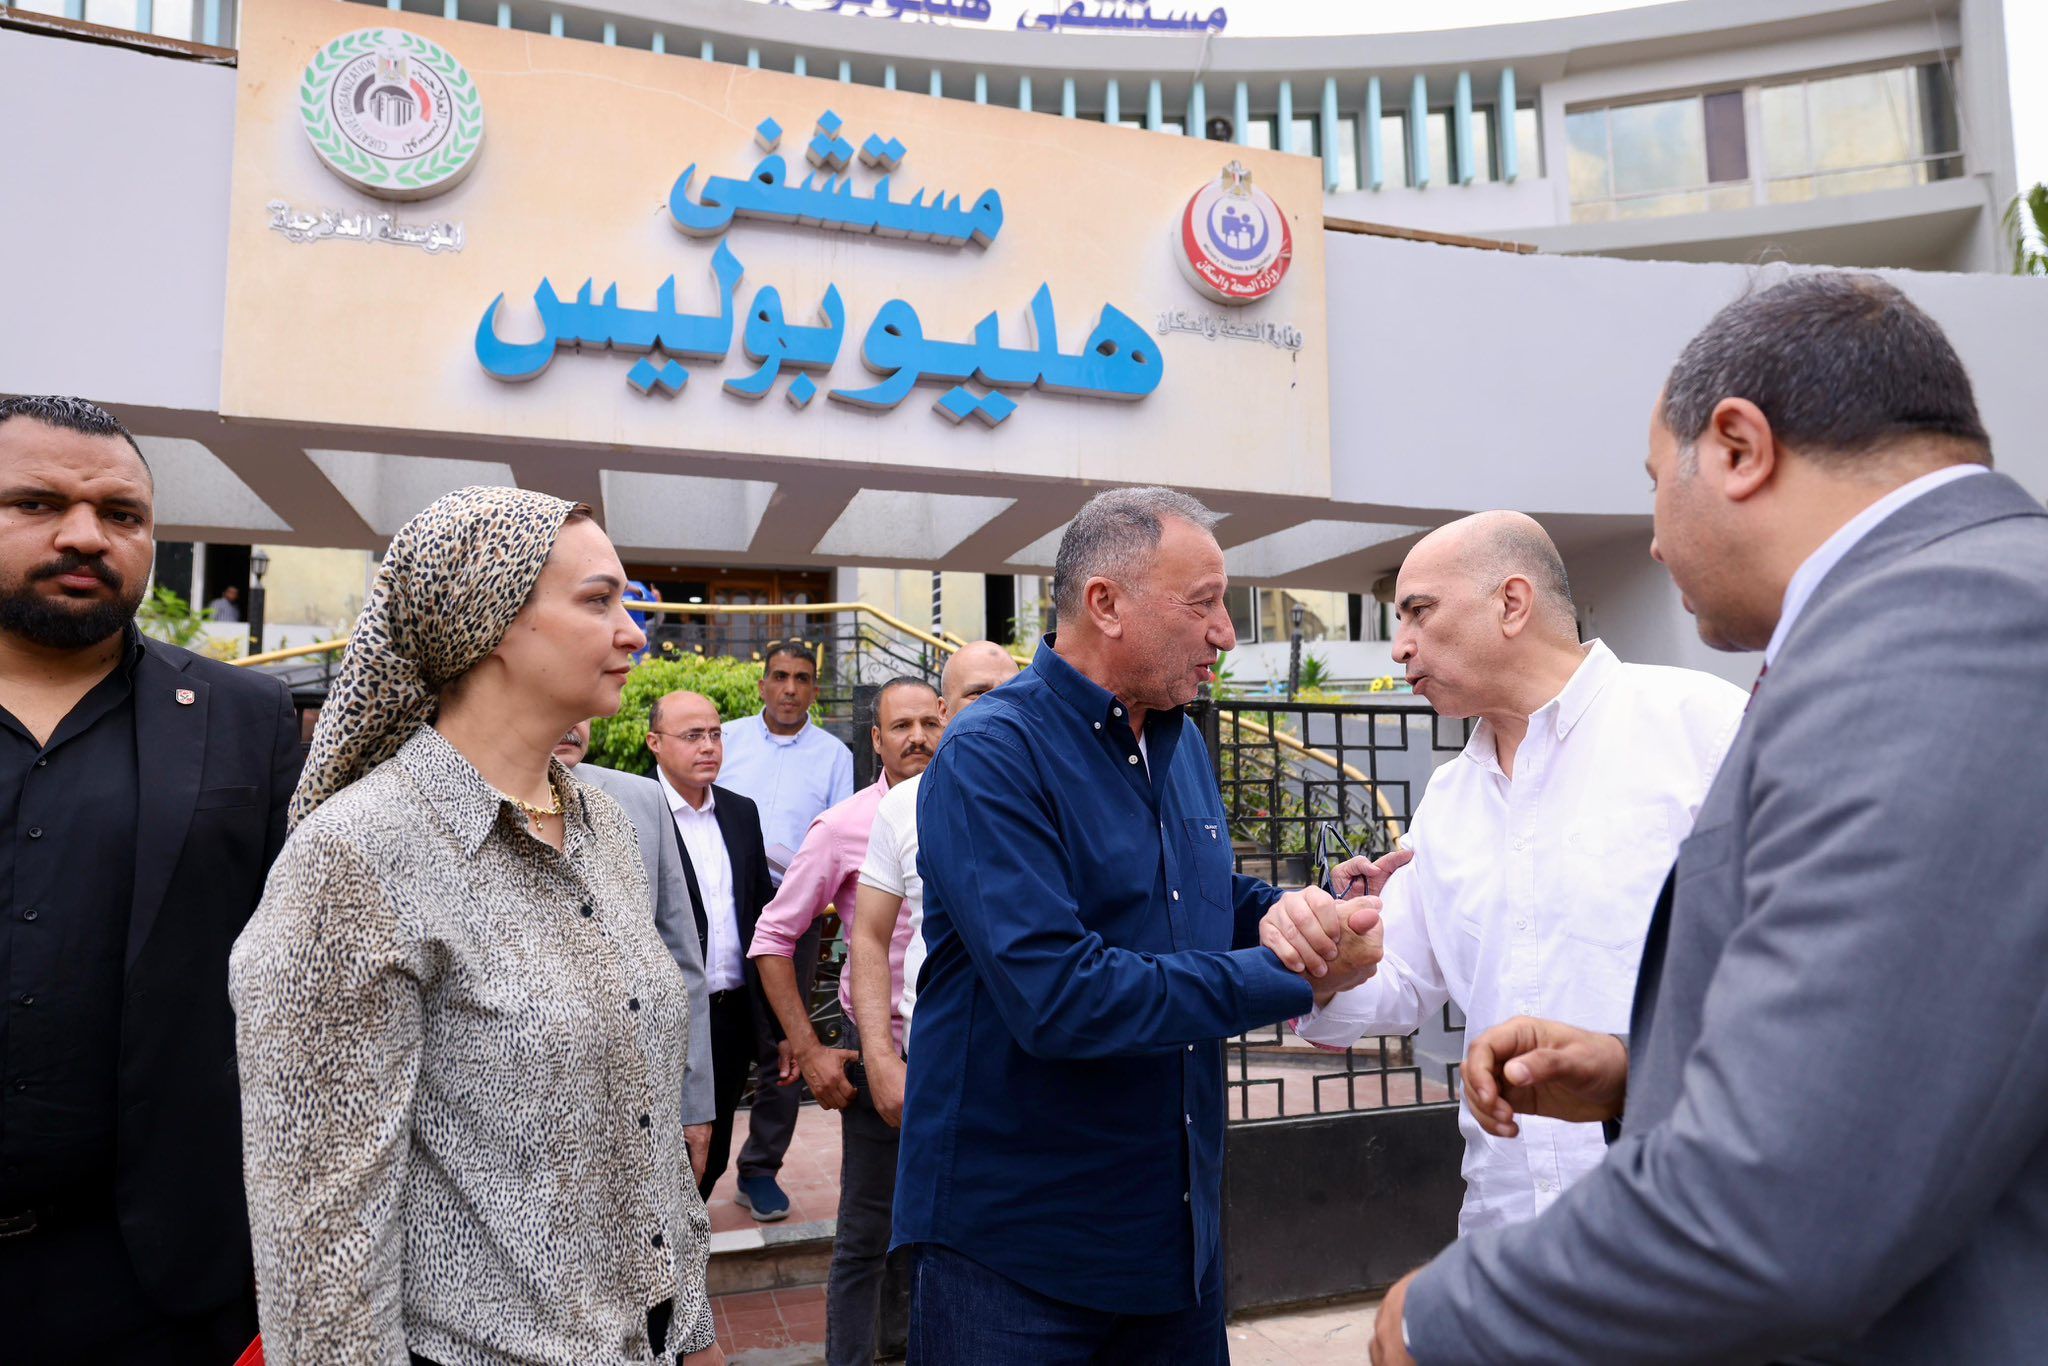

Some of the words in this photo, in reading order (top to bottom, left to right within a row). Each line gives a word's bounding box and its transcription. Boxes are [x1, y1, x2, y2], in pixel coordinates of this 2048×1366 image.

[339, 58, 376, 118] ORGANIZATION
[343, 117, 388, 152] CURATIVE
[668, 110, 1004, 249] مستشفى
[267, 201, 374, 243] العلاجية
[1196, 260, 1230, 291] والسكان
[1230, 277, 1259, 293] الصحة
[475, 237, 1164, 428] هليوبوليس
[1157, 311, 1217, 340] والسكان
[1218, 315, 1266, 342] الصحة
[1266, 322, 1303, 351] وزارة
